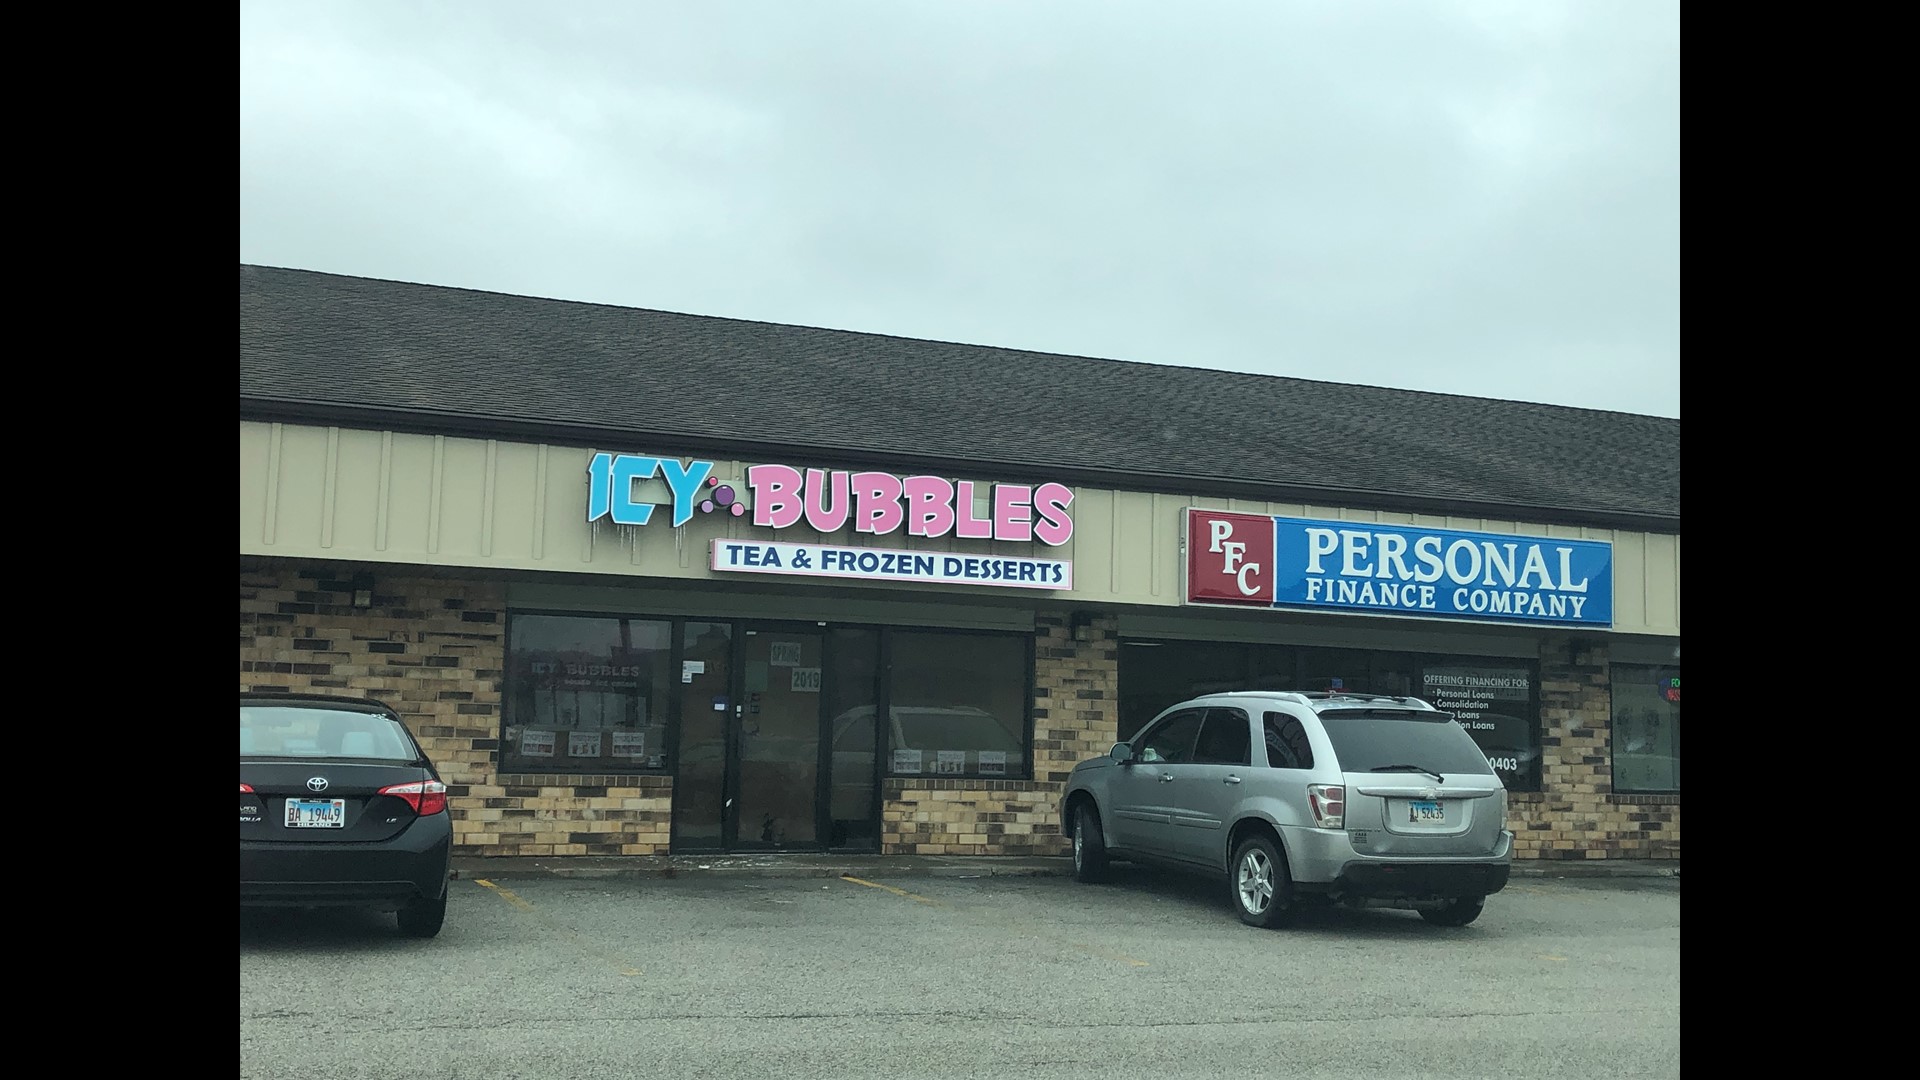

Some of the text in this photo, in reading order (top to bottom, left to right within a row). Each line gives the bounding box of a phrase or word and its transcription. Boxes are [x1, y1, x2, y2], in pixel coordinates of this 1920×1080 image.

[588, 453, 1075, 546] ICY BUBBLES
[726, 545, 1063, 584] TEA & FROZEN DESSERTS
[1208, 519, 1261, 596] PFC
[1305, 527, 1588, 593] PERSONAL
[1305, 578, 1587, 619] FINANCE COMPANY
[566, 663, 640, 677] BUBBLES
[793, 672, 819, 688] 2019
[1424, 675, 1529, 687] OFFERING FINANCING FOR:
[1436, 689, 1494, 699] Personal Loans
[1436, 700, 1489, 709] Consolidation
[1458, 711, 1480, 719] Loans
[1473, 722, 1495, 730] Loans
[288, 808, 340, 822] BA 19449
[1422, 808, 1444, 819] 52435
